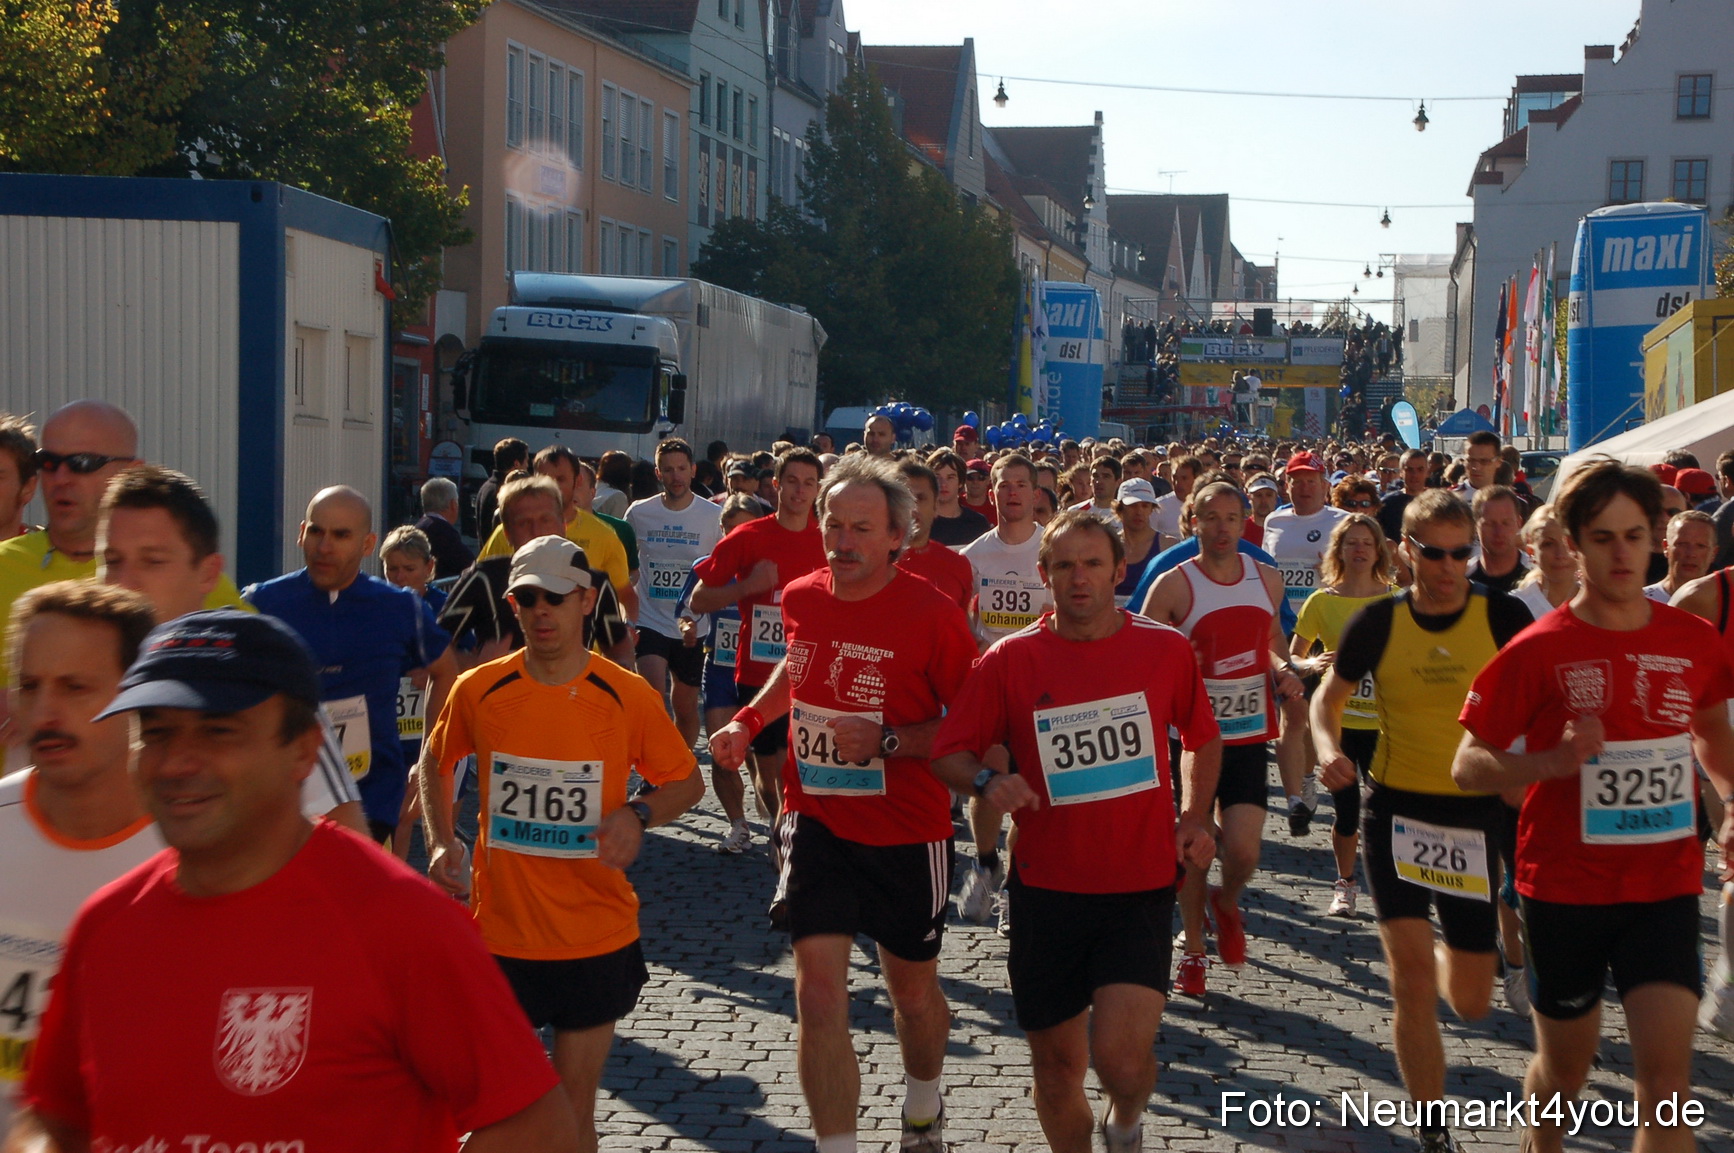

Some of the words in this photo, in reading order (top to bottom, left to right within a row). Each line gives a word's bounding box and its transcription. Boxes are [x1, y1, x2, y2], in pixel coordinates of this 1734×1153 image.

[1601, 225, 1693, 273] maxi
[527, 312, 614, 331] BOCK
[1046, 298, 1087, 328] axi
[1059, 342, 1082, 359] dsl
[1204, 342, 1264, 358] BOCK
[992, 590, 1031, 612] 393
[831, 641, 841, 649] 11.
[841, 642, 895, 659] NEUMARKTER
[838, 649, 882, 663] STADTLAUF
[851, 685, 886, 696] 19.09.2010
[1051, 710, 1099, 726] PFLEIDERER
[1051, 721, 1142, 769] 3509
[1597, 763, 1684, 806] 3252
[501, 780, 587, 822] 2163
[515, 821, 569, 845] Mario
[1413, 840, 1467, 872] 226
[1420, 867, 1464, 888] Klaus
